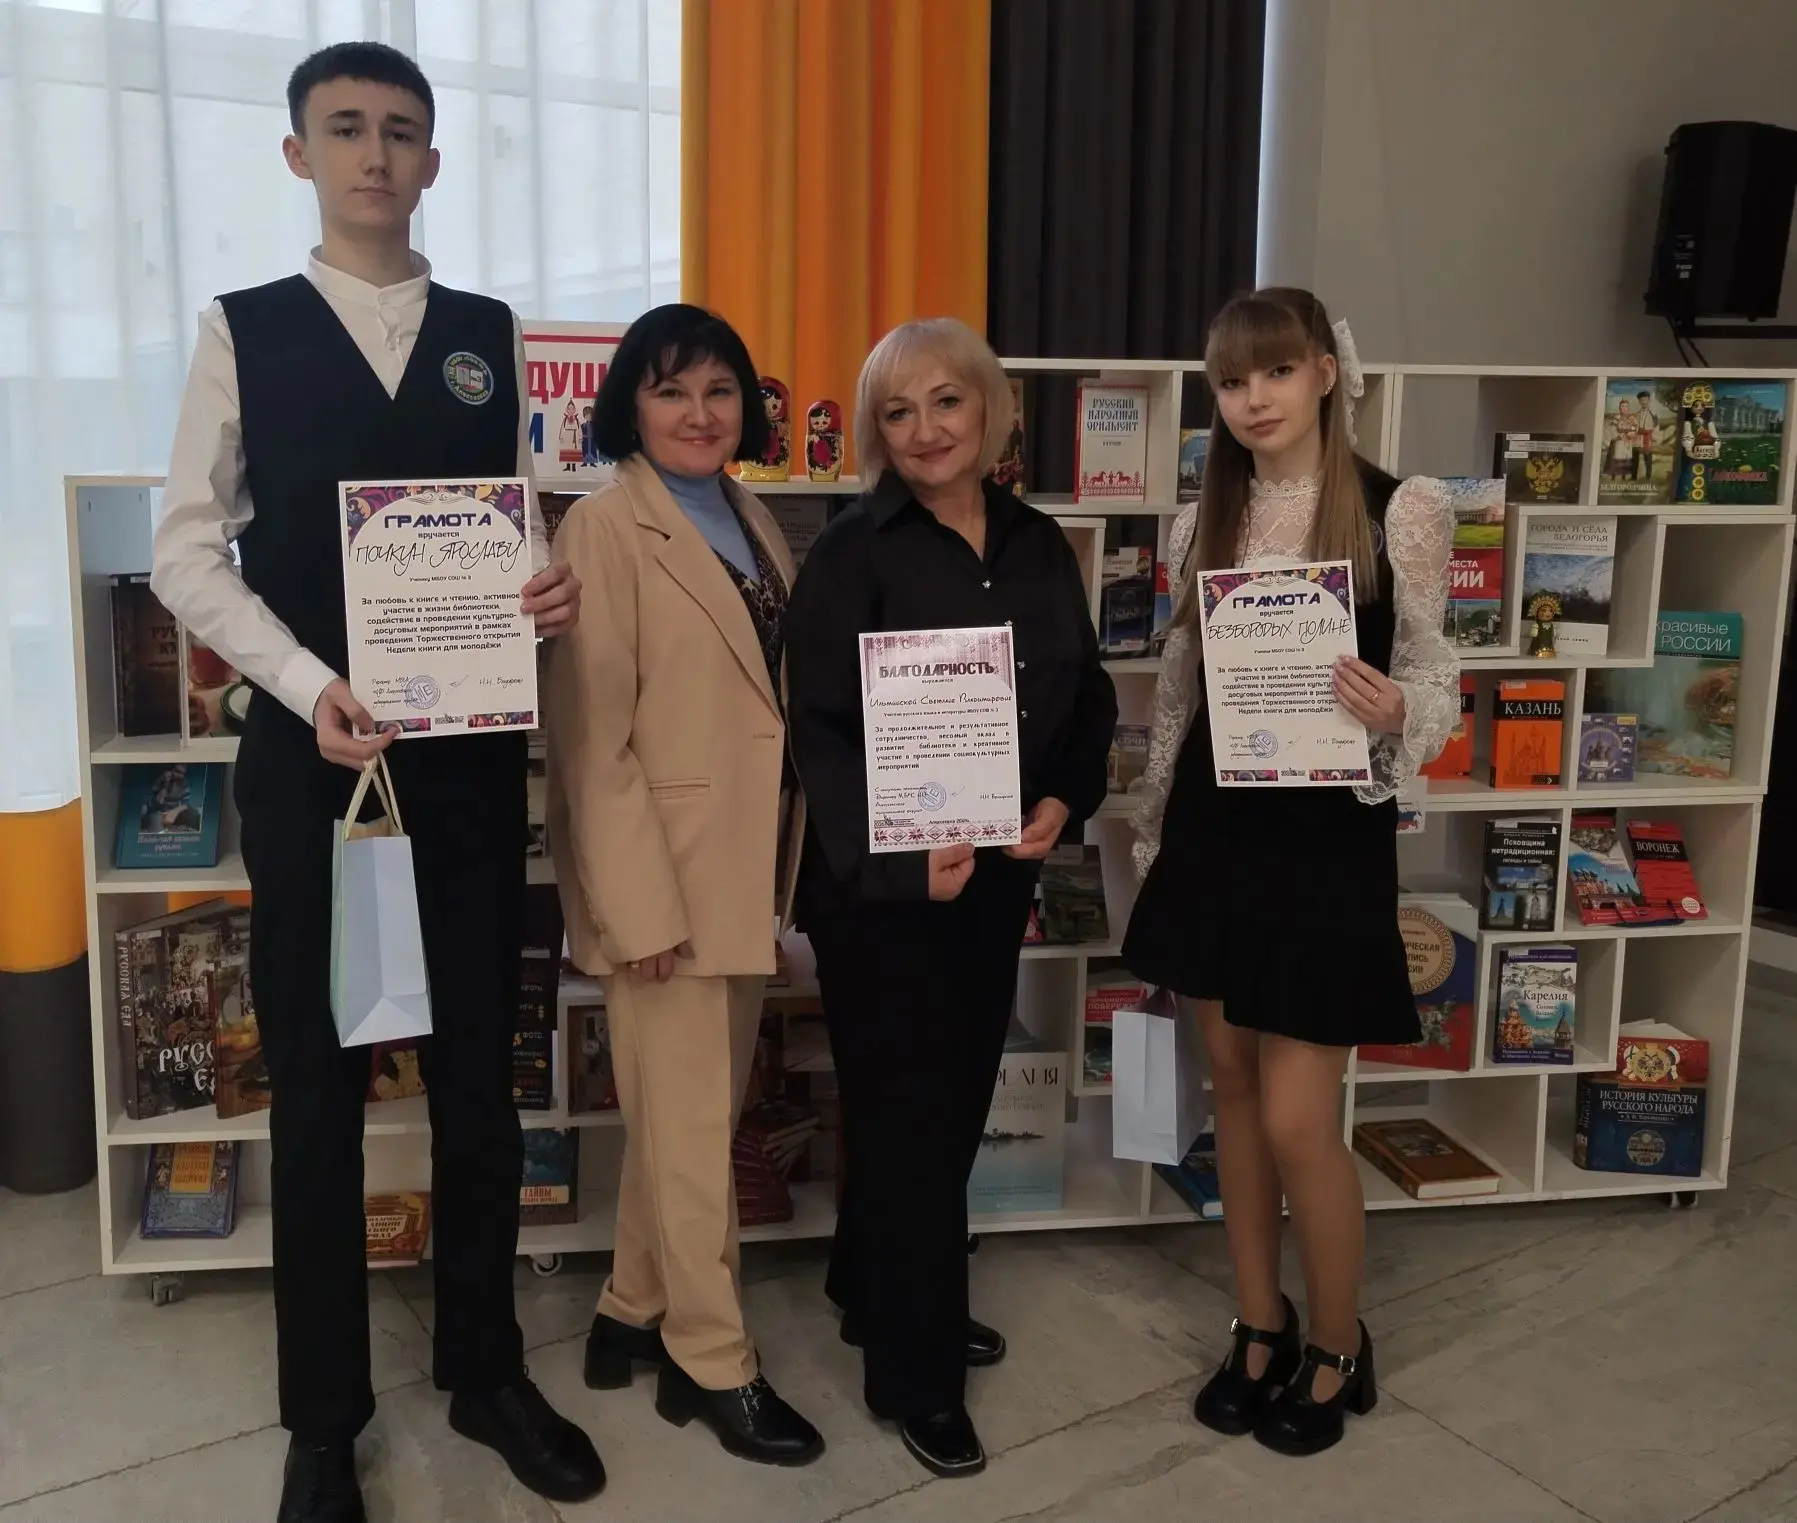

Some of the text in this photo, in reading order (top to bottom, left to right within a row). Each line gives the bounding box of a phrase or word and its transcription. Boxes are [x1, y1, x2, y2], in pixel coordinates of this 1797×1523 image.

[1092, 398, 1134, 409] РУССКИЙ
[1088, 410, 1138, 421] НАРОДНЫЙ
[1087, 421, 1138, 432] ОРНАМЕНТ
[384, 513, 491, 528] ГРАМОТА
[1531, 524, 1567, 533] ГОРОДА
[1582, 525, 1608, 534] СЁЛА
[418, 532, 460, 540] вручается
[1553, 533, 1608, 542] БЕЛОГОРЬЯ
[430, 539, 523, 573] ЯРОСЛАВУ
[1449, 560, 1478, 568] МЕСТА
[375, 597, 406, 605] любовь
[1233, 592, 1321, 609] ГРАМОТА
[383, 607, 415, 615] участие
[367, 616, 414, 625] содействие
[423, 614, 471, 623] проведении
[473, 612, 517, 621] культурно-
[152, 626, 177, 639] РУС
[374, 626, 418, 635] досуговых
[420, 623, 473, 634] мероприятий
[482, 622, 511, 631] рамках
[1207, 617, 1352, 644] БЕЗБОРОДЫХ ПОЛИНЕ
[365, 632, 521, 645] проведения Торжественного открытия
[1661, 635, 1731, 652] РОССИИ
[386, 646, 416, 654] Недели
[444, 644, 459, 652] для
[461, 641, 502, 650] молодёжи
[879, 661, 995, 679] БЛАГОДАРНОСТЬ
[1264, 689, 1307, 698] мероприятий
[1504, 702, 1562, 715] КАЗАНЬ
[888, 724, 945, 733] продолжительное
[959, 721, 1009, 730] результативное
[875, 735, 929, 743] сотрудничество,
[973, 740, 1010, 748] креативное
[1117, 736, 1146, 746] СОЧИ
[876, 754, 902, 762] участие
[913, 752, 950, 761] проведении
[953, 750, 1010, 758] социокультурных
[877, 763, 920, 771] мероприятий
[1503, 838, 1546, 847] Псковщина
[1636, 842, 1680, 854] ВОРОНЕЖ
[1491, 848, 1556, 856] нетрадиционная:
[118, 946, 131, 1001] РУССКАЯ
[1523, 990, 1568, 1003] Карелия
[1600, 1090, 1645, 1101] ИСТОРИЯ
[1648, 1092, 1698, 1106] КУЛЬТУРЫ
[1602, 1101, 1653, 1112] РУССКОГО
[1655, 1103, 1694, 1114] НАРОДА
